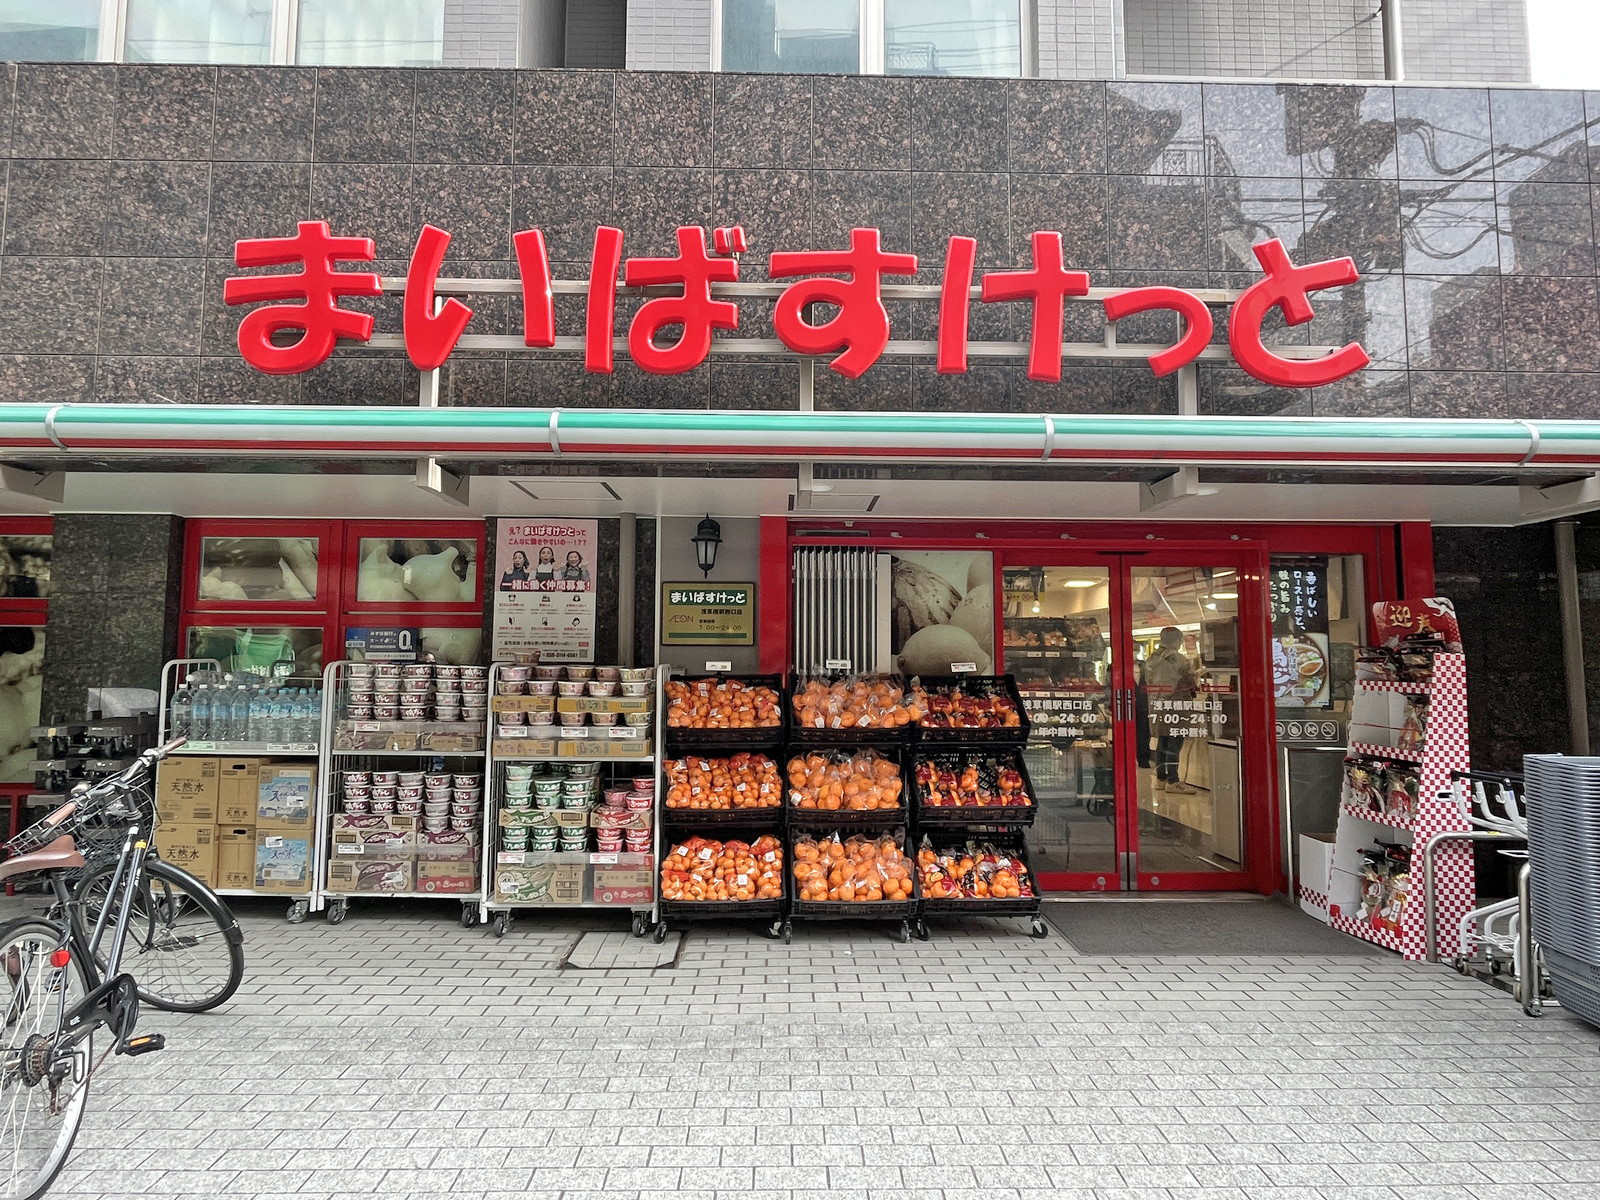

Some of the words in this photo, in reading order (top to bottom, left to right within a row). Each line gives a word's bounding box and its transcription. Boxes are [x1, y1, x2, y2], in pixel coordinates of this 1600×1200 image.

[223, 219, 1370, 388] まいばすけっと
[670, 591, 746, 604] まいばすけっと
[1153, 700, 1223, 711] 浅草橋駅西口店
[1169, 727, 1209, 738] 年中無休
[170, 781, 205, 793] 天然水
[225, 809, 249, 817] 天然水
[166, 848, 200, 860] 天然水
[225, 874, 249, 882] 天然水
